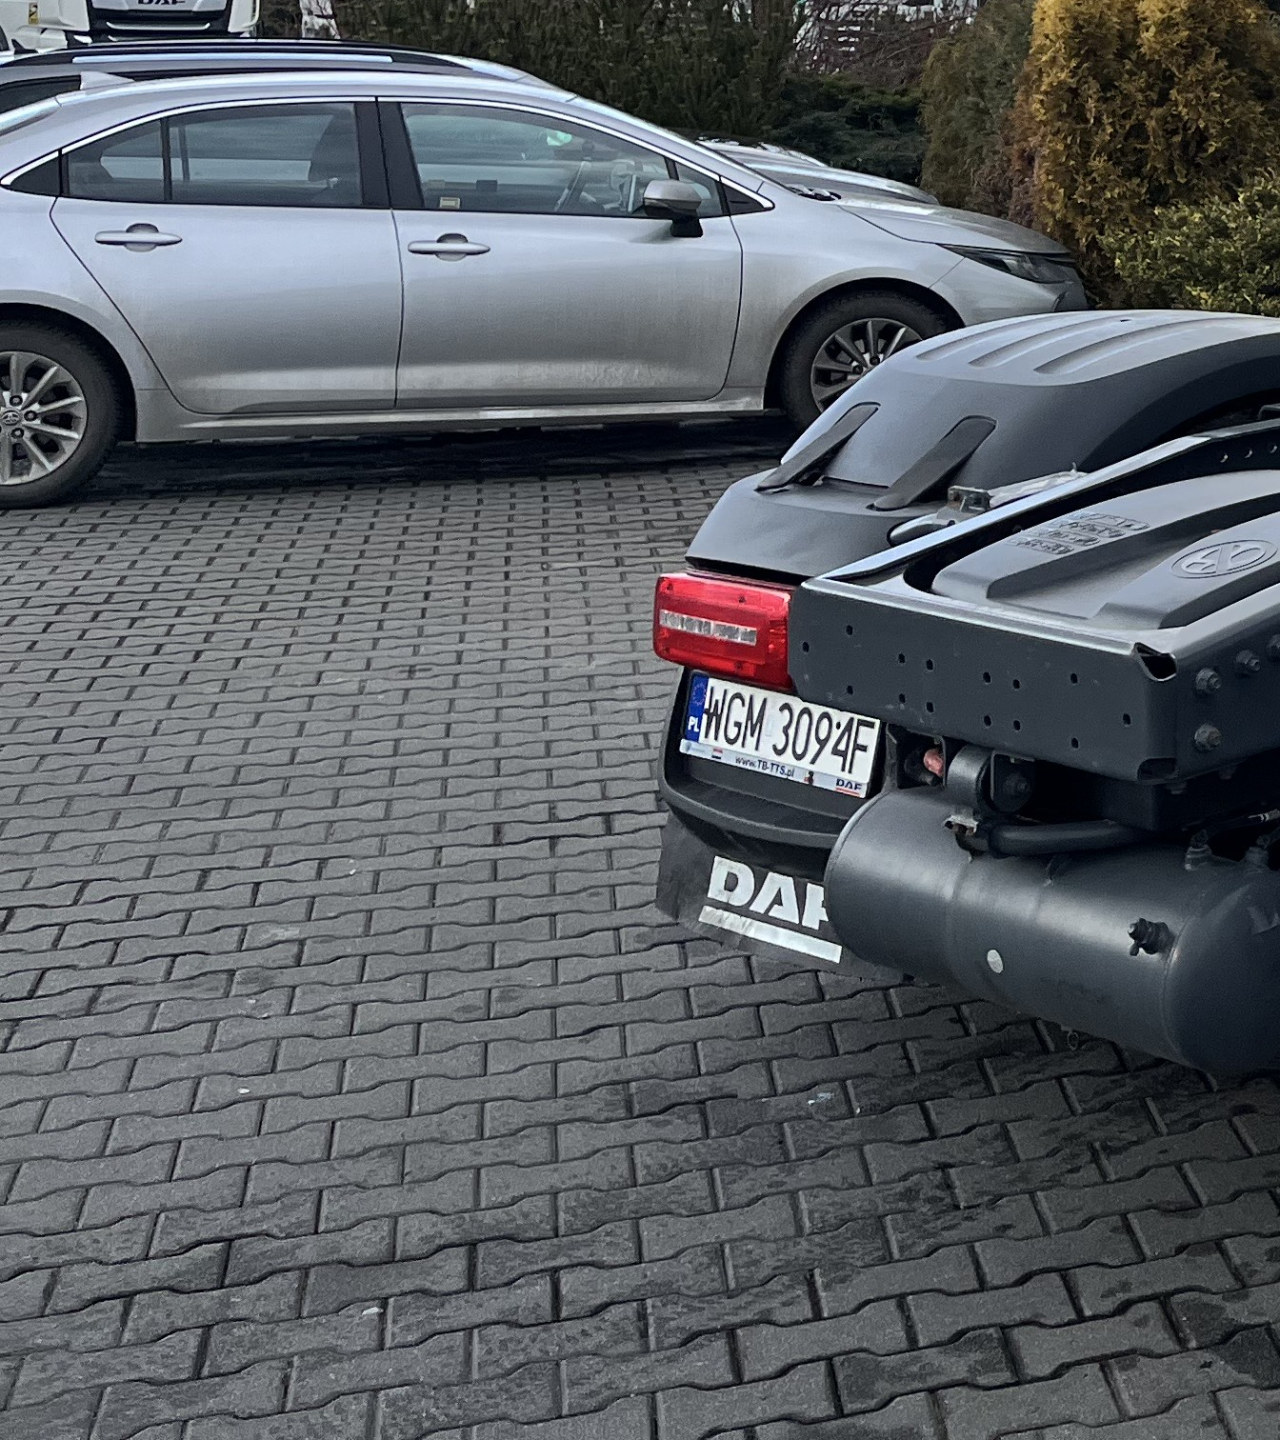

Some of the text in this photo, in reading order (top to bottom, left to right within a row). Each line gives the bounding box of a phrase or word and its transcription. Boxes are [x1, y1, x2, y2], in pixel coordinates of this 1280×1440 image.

[687, 715, 700, 733] PL
[702, 685, 876, 774] WGM 3094F
[835, 777, 863, 791] DAF
